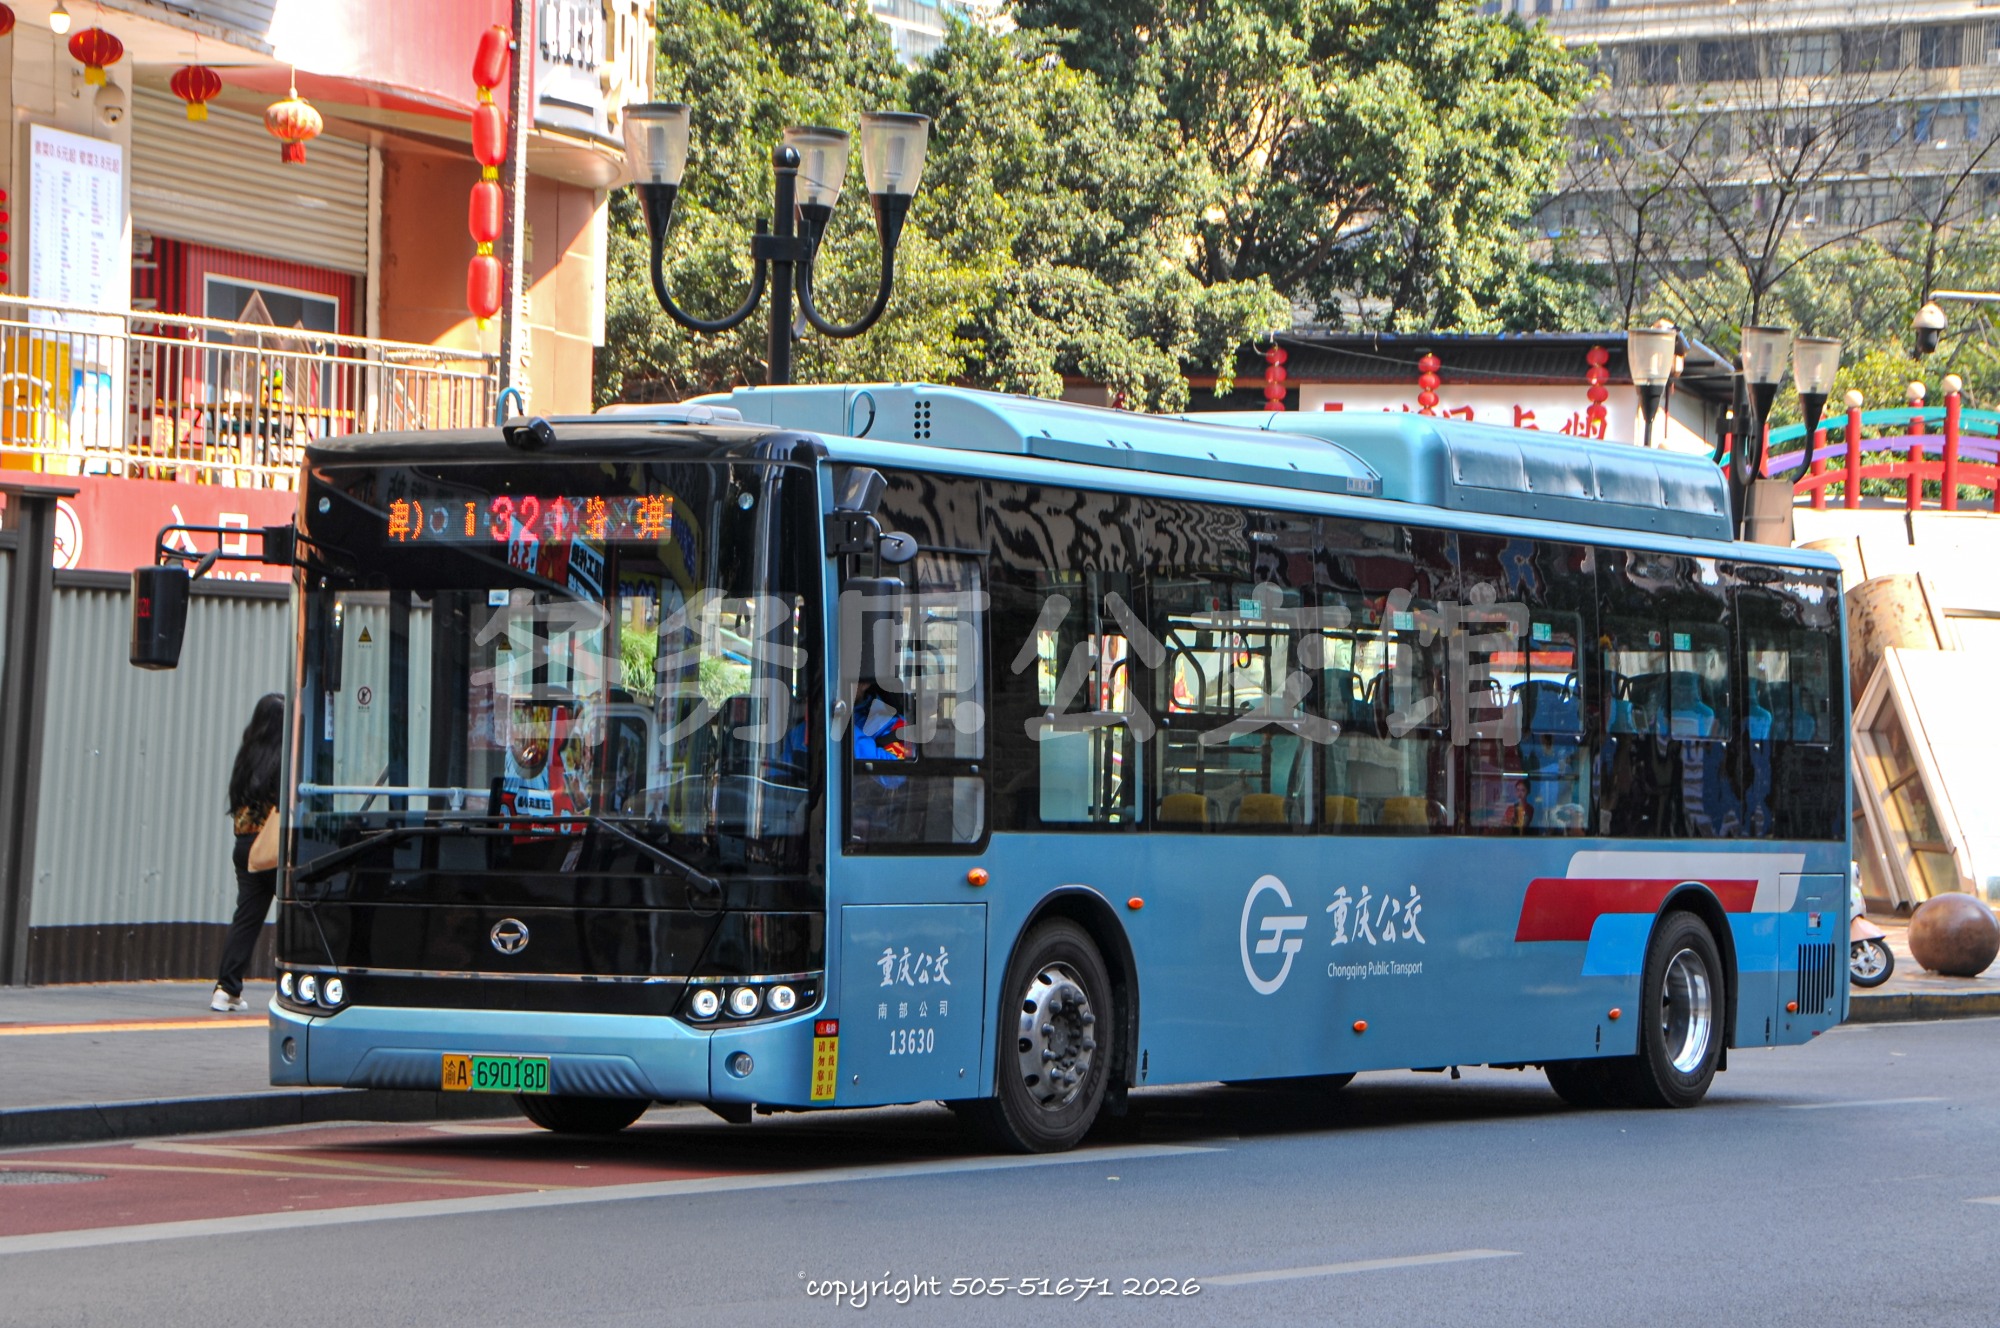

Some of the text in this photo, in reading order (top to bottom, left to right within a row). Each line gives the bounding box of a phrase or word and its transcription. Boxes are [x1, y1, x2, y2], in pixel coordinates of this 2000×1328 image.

[165, 504, 249, 556] 入口
[1325, 884, 1426, 947] 重庆公交
[876, 945, 951, 988] 重庆公交
[1327, 960, 1423, 981] Chongqing Public Transport
[877, 1000, 948, 1021] 南部公司
[889, 1027, 935, 1056] 13630
